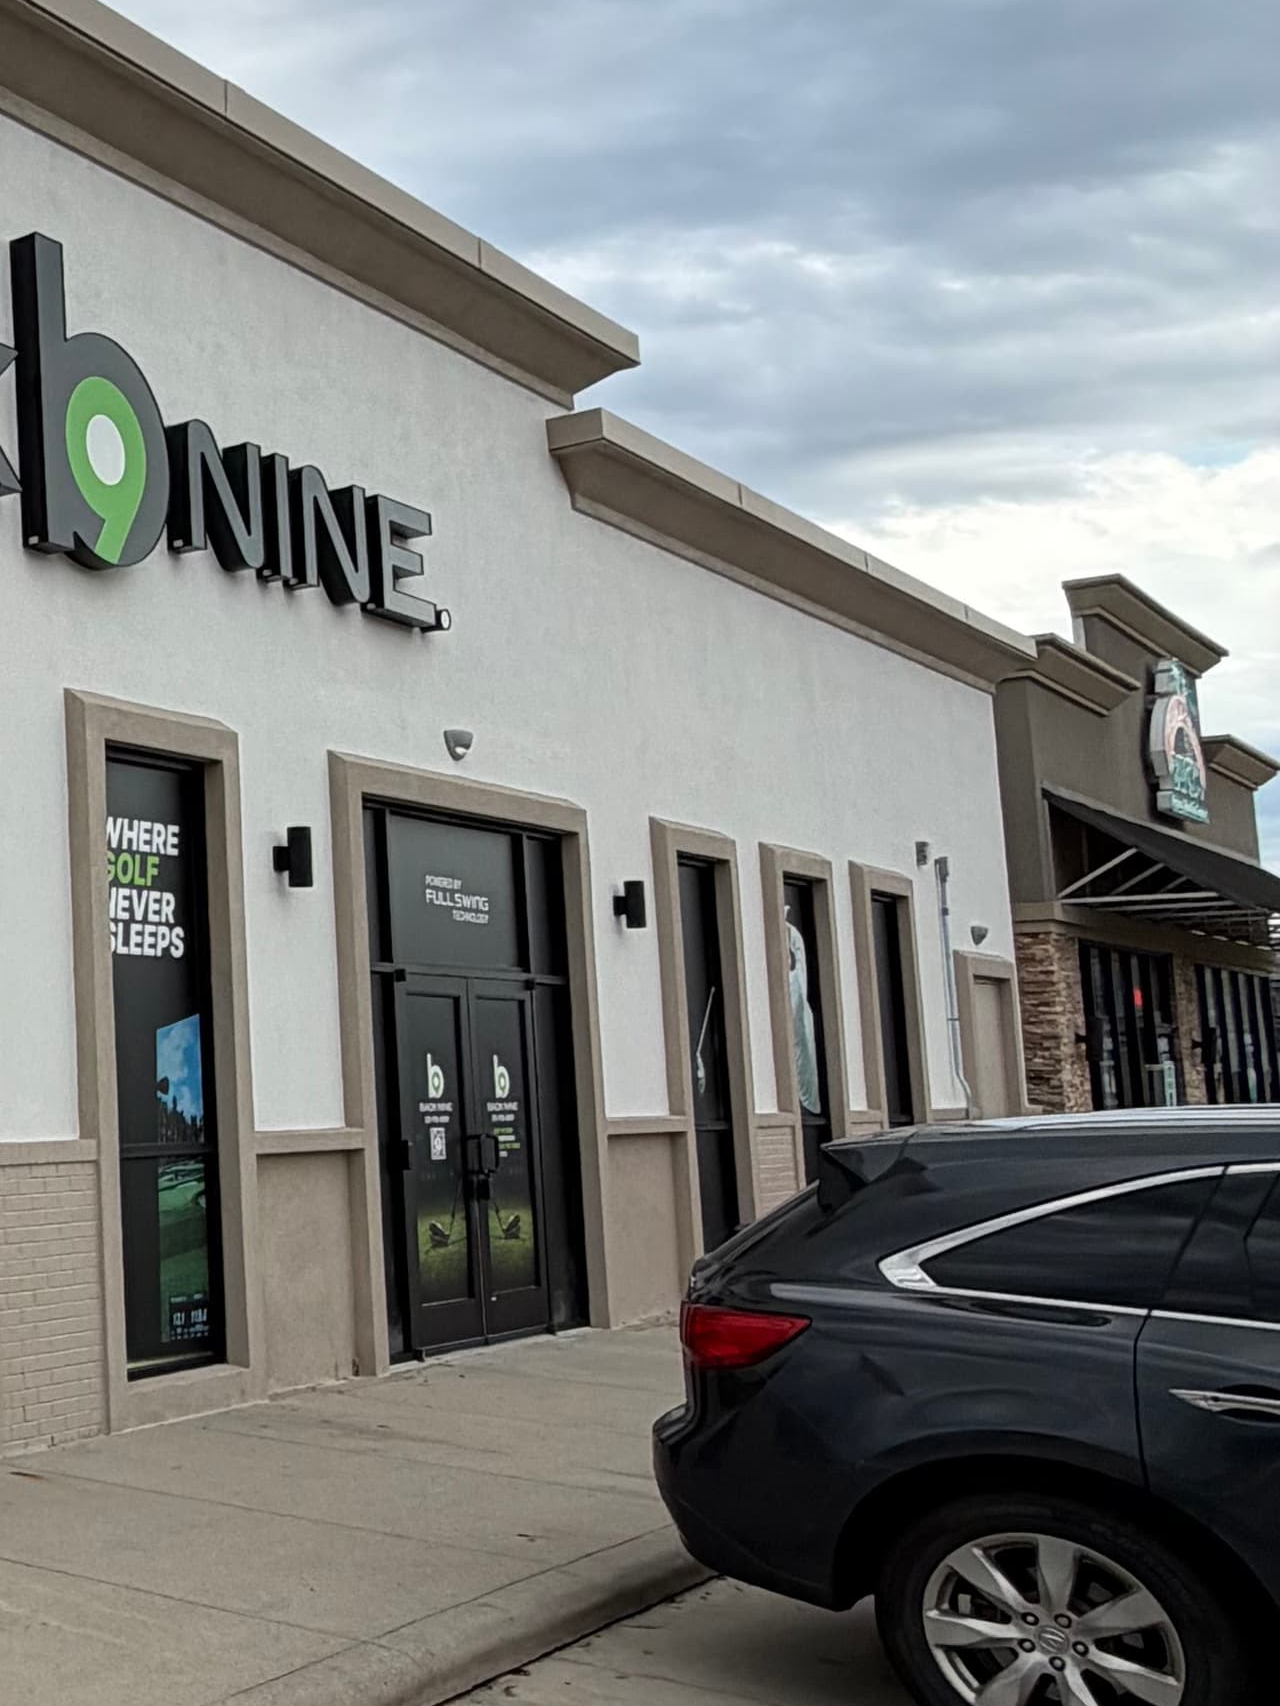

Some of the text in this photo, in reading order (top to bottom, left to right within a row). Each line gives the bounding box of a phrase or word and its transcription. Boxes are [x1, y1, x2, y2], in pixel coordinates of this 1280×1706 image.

[166, 419, 437, 631] NINE
[425, 888, 489, 911] FULL SWING
